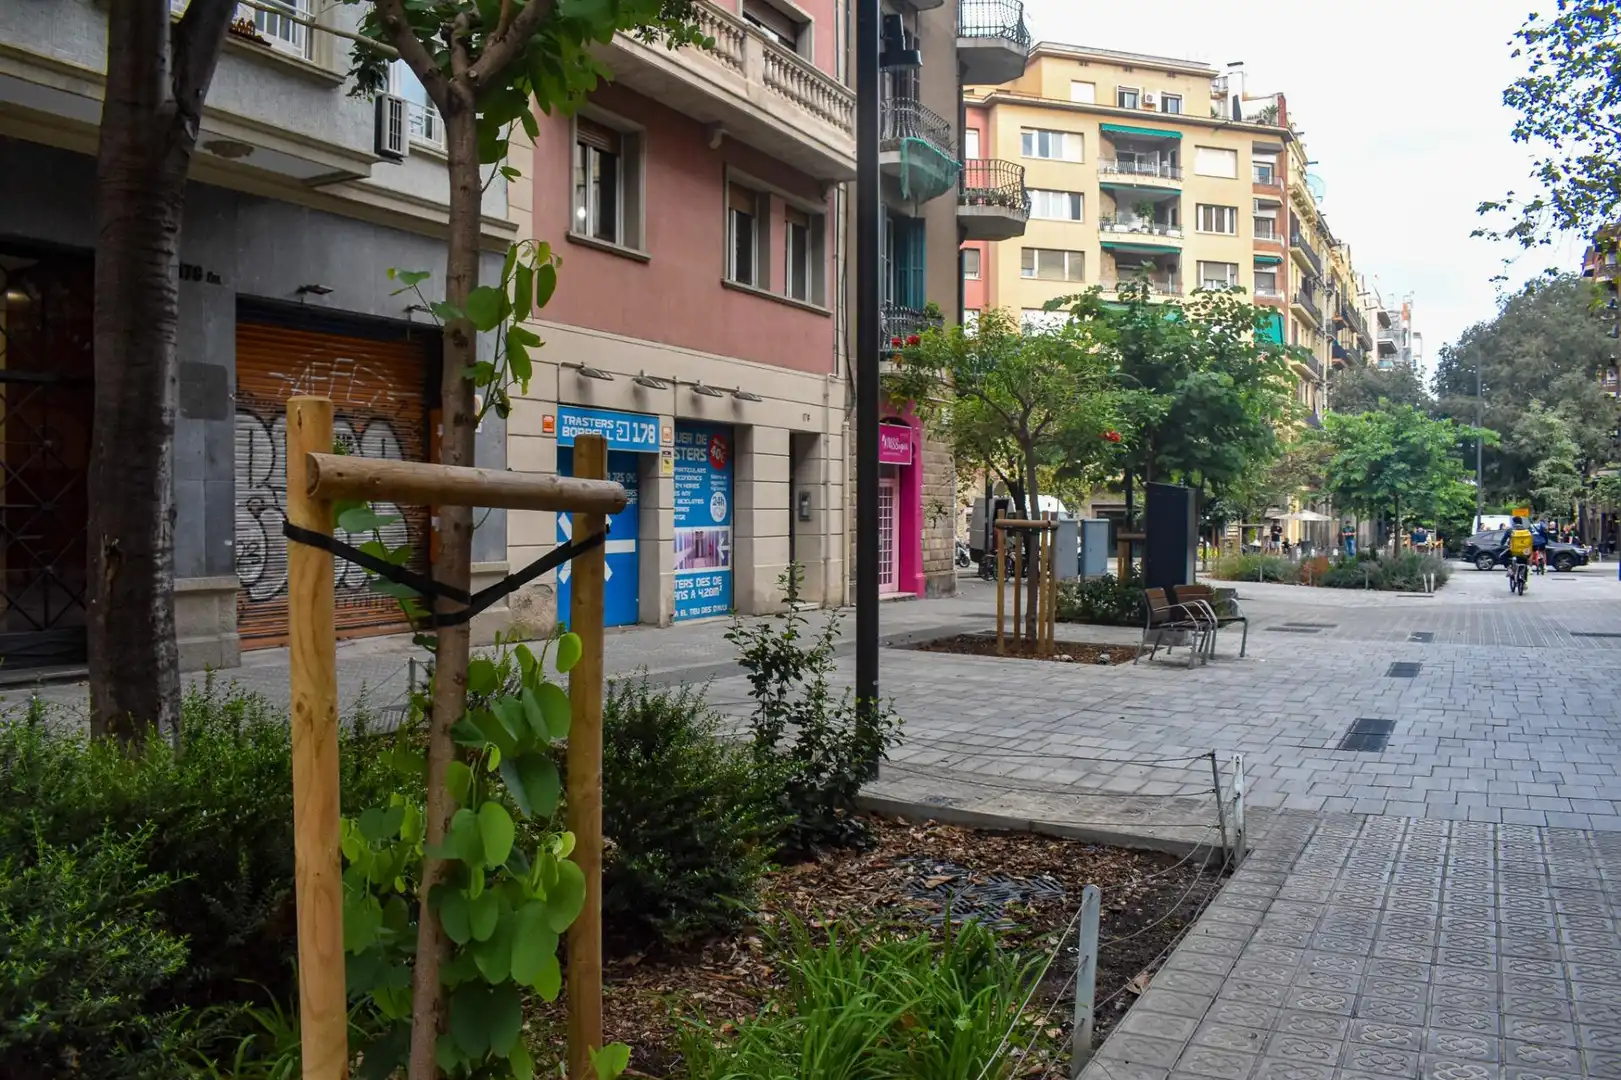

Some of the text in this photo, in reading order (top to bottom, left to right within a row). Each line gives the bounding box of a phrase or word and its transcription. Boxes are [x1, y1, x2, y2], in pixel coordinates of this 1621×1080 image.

[562, 415, 614, 429] TRASTERS
[632, 422, 656, 443] 178
[696, 433, 708, 445] DE
[696, 576, 711, 588] DES
[713, 576, 722, 585] DE
[690, 590, 696, 599] A
[701, 606, 712, 614] DES
